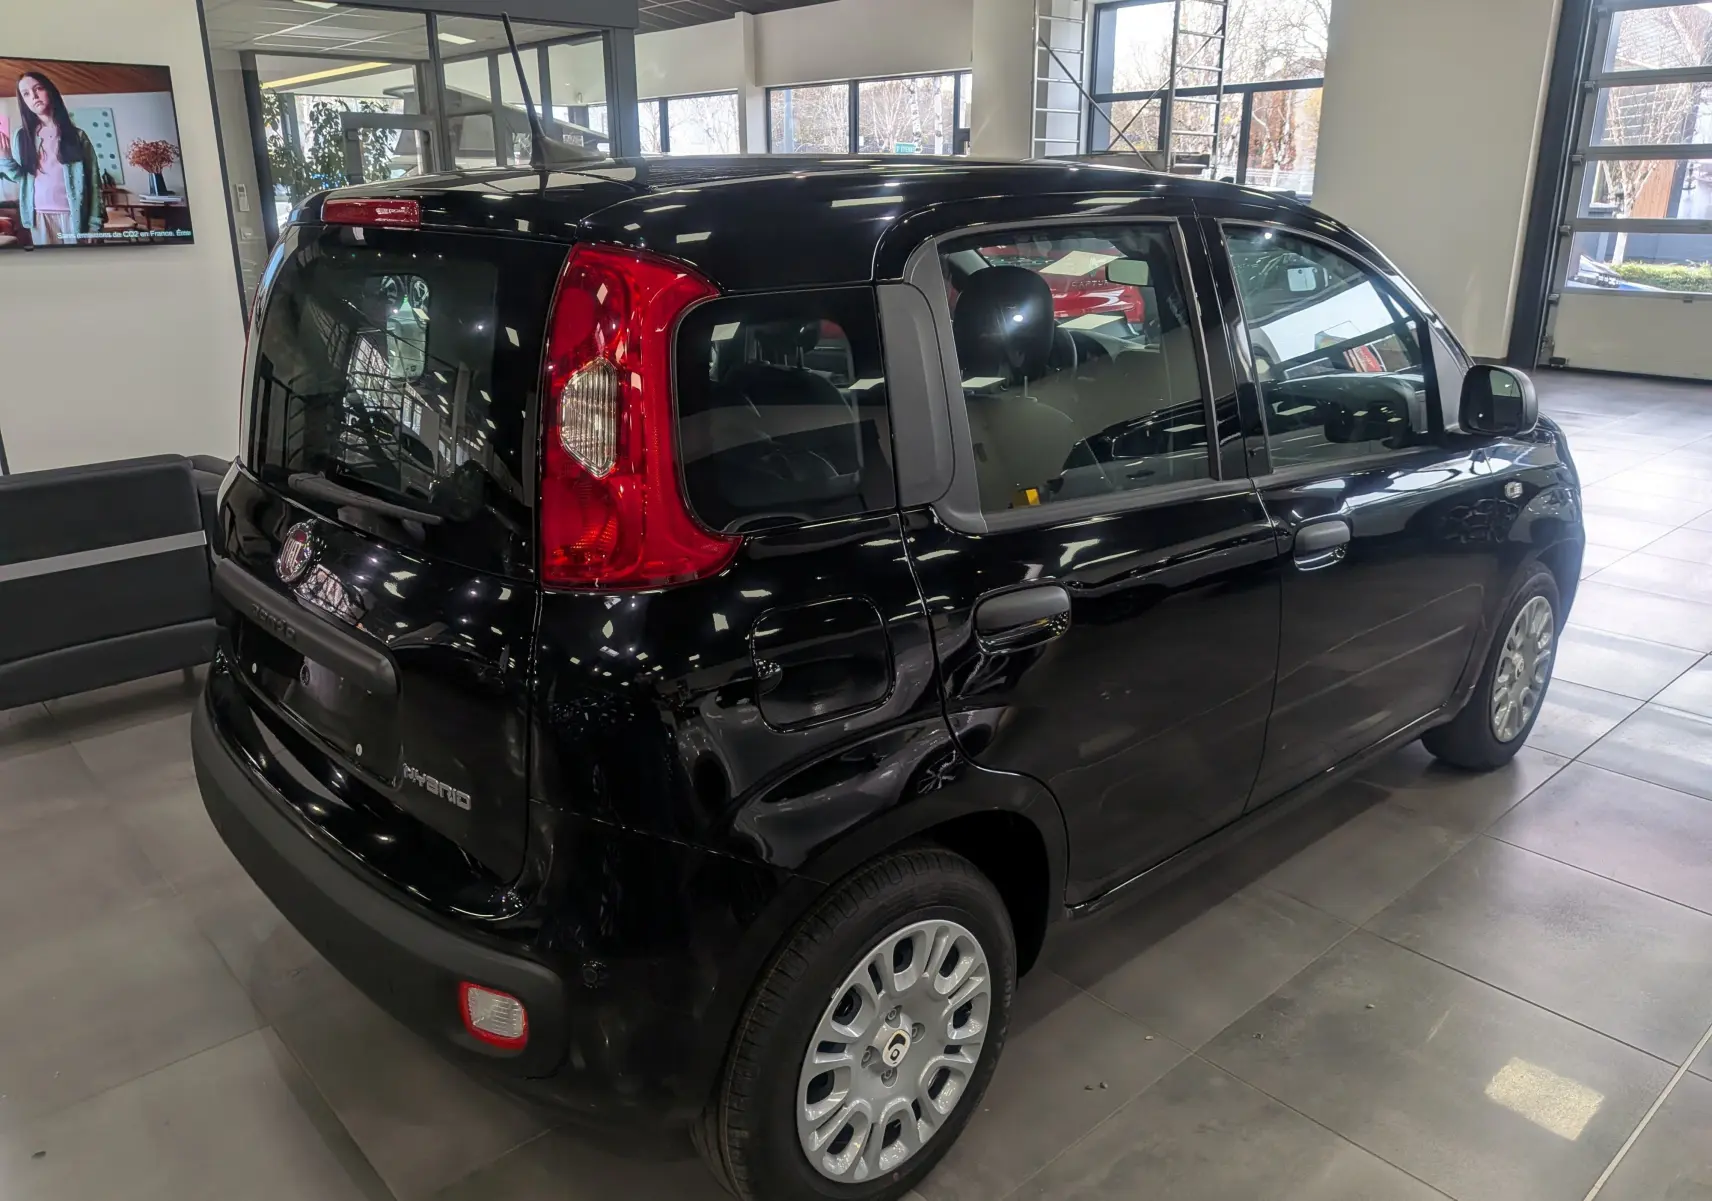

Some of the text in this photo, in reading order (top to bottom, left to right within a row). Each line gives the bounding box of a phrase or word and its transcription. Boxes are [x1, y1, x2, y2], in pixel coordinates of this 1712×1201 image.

[113, 230, 122, 238] de
[123, 230, 139, 238] CO2
[151, 229, 175, 237] France.
[403, 763, 472, 811] HYBRID
